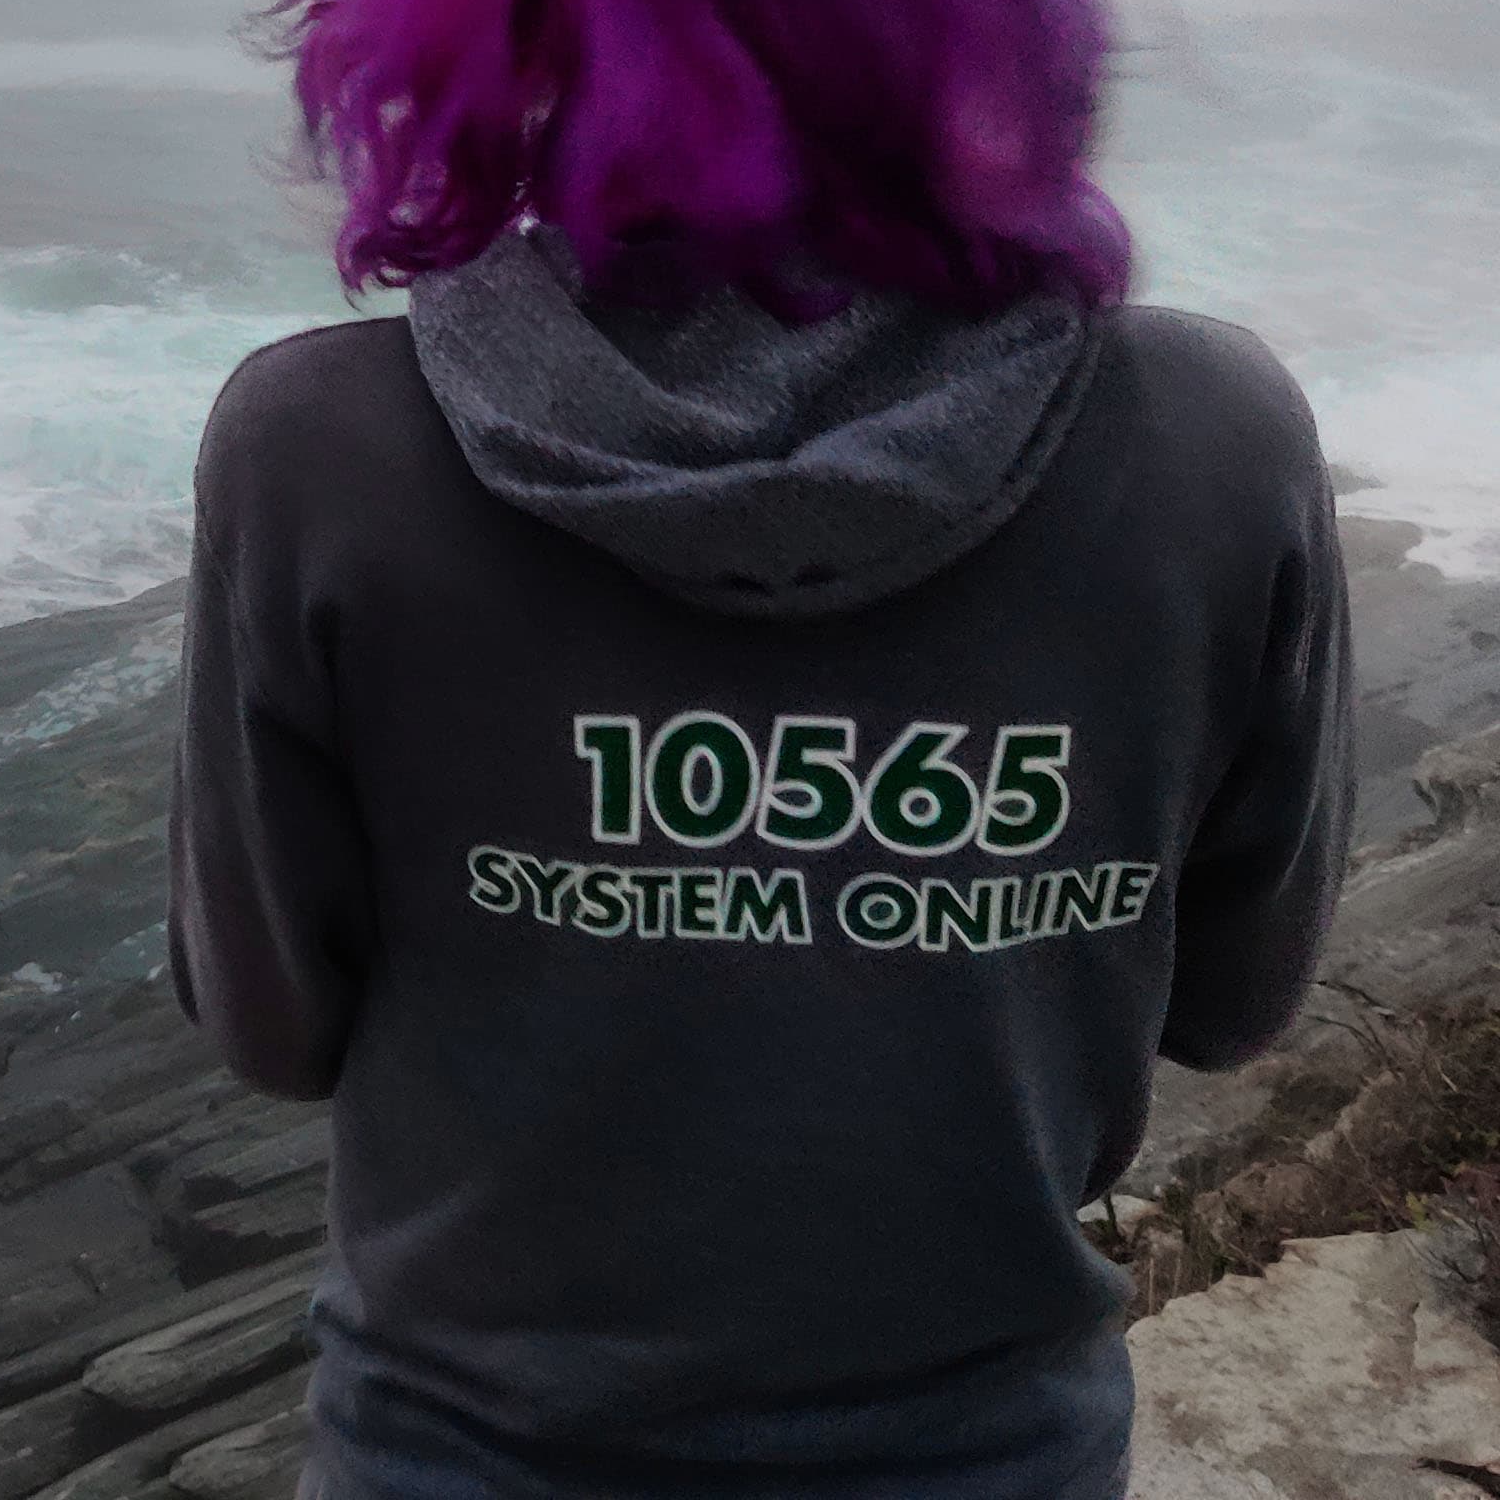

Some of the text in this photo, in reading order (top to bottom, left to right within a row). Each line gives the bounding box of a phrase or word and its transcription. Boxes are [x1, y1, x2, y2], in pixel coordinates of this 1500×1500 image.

[574, 711, 1072, 857] 10565
[468, 846, 1159, 952] SYSTEM ONLINE
